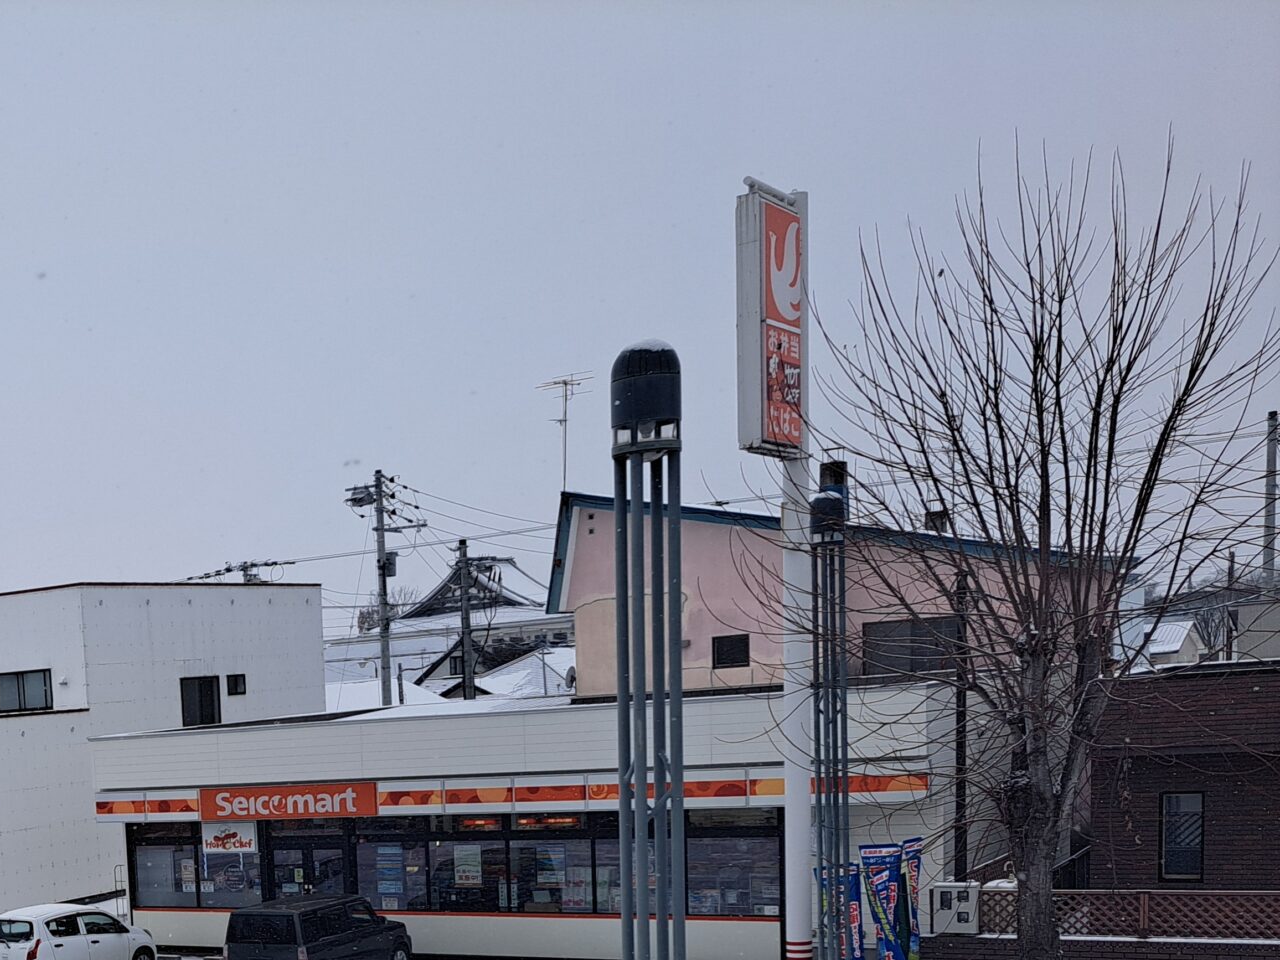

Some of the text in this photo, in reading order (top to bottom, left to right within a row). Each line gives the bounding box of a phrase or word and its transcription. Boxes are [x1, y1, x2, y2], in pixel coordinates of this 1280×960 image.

[768, 329, 800, 359] お弁当
[768, 405, 800, 437] たばこ
